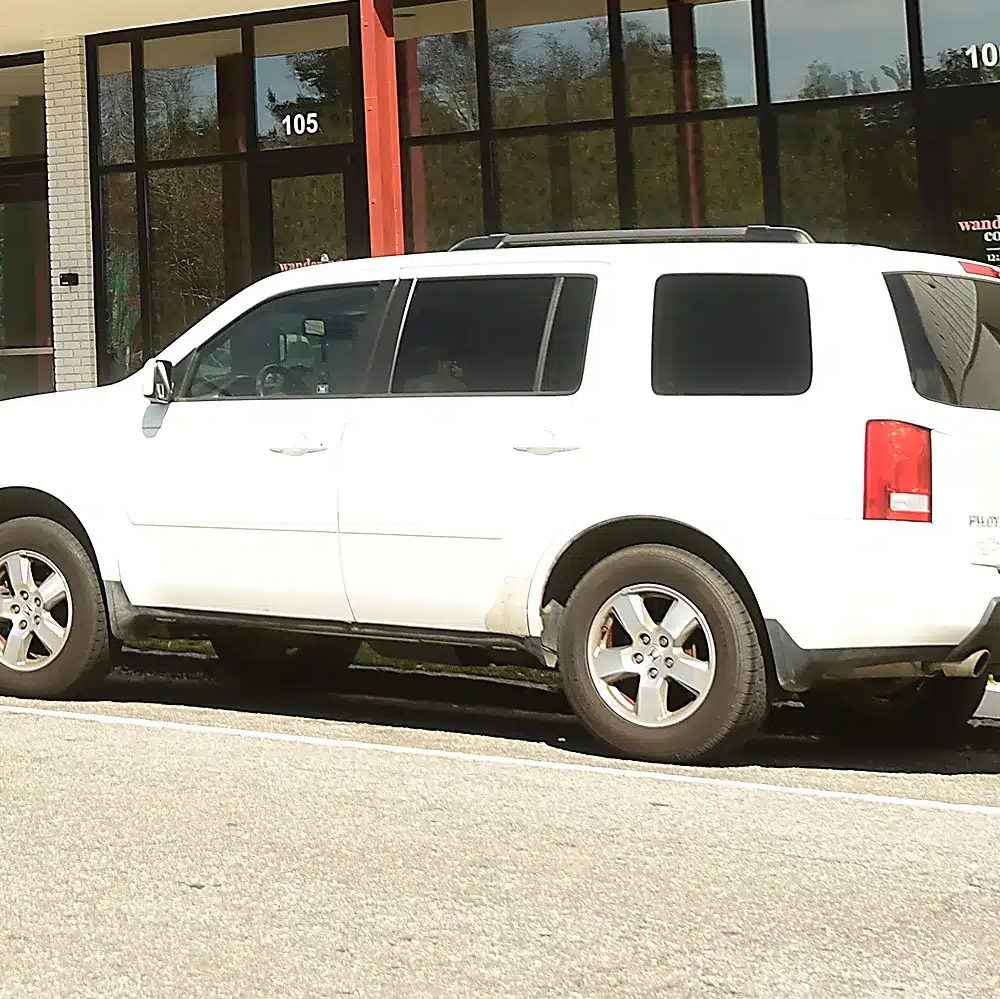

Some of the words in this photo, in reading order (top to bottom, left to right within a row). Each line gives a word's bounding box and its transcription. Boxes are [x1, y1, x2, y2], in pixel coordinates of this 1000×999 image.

[965, 42, 1000, 68] 10
[282, 113, 318, 135] 105
[969, 515, 1000, 528] PILOT
